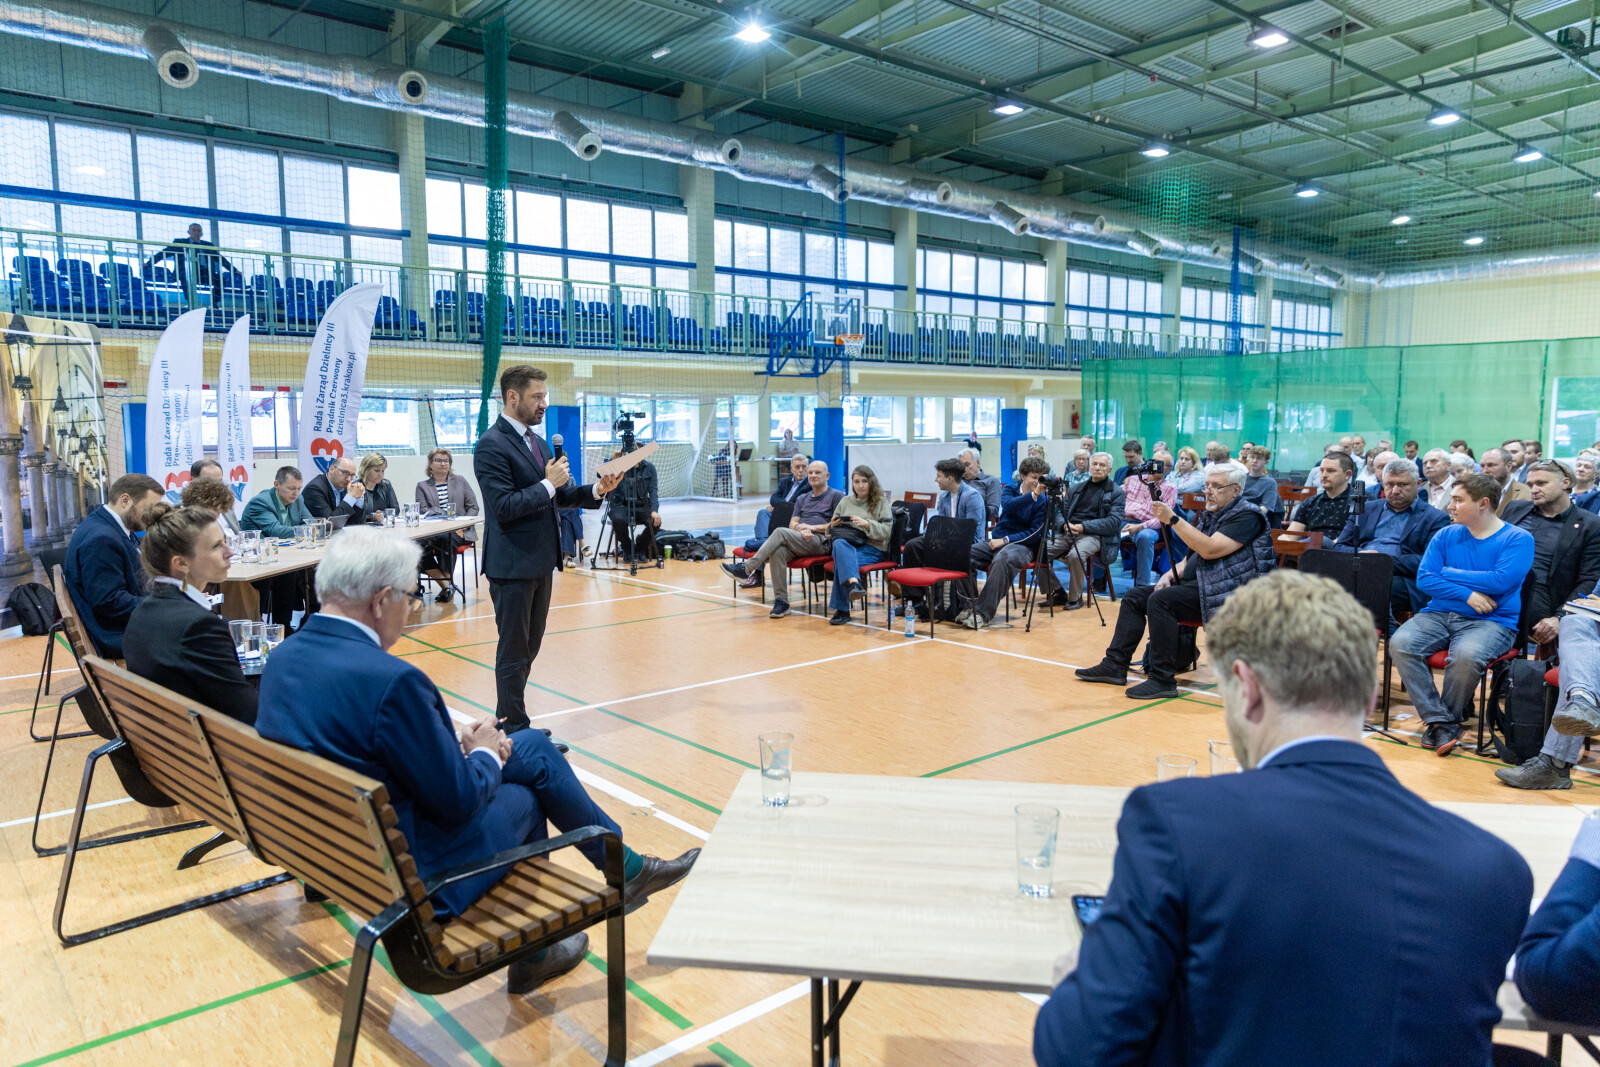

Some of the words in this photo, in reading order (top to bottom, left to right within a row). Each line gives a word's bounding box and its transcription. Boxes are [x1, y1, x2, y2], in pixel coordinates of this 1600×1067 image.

[327, 323, 335, 332] III
[161, 361, 169, 369] III
[320, 333, 335, 373] Dzielnicy
[317, 374, 329, 404] Zarząd
[330, 357, 343, 399] Czerwony
[337, 351, 356, 435] dzielnica3.krakow.pl
[163, 411, 172, 440] Zarząd
[314, 411, 324, 432] Rada
[326, 400, 336, 434] Prądnik
[164, 447, 173, 467] Rada
